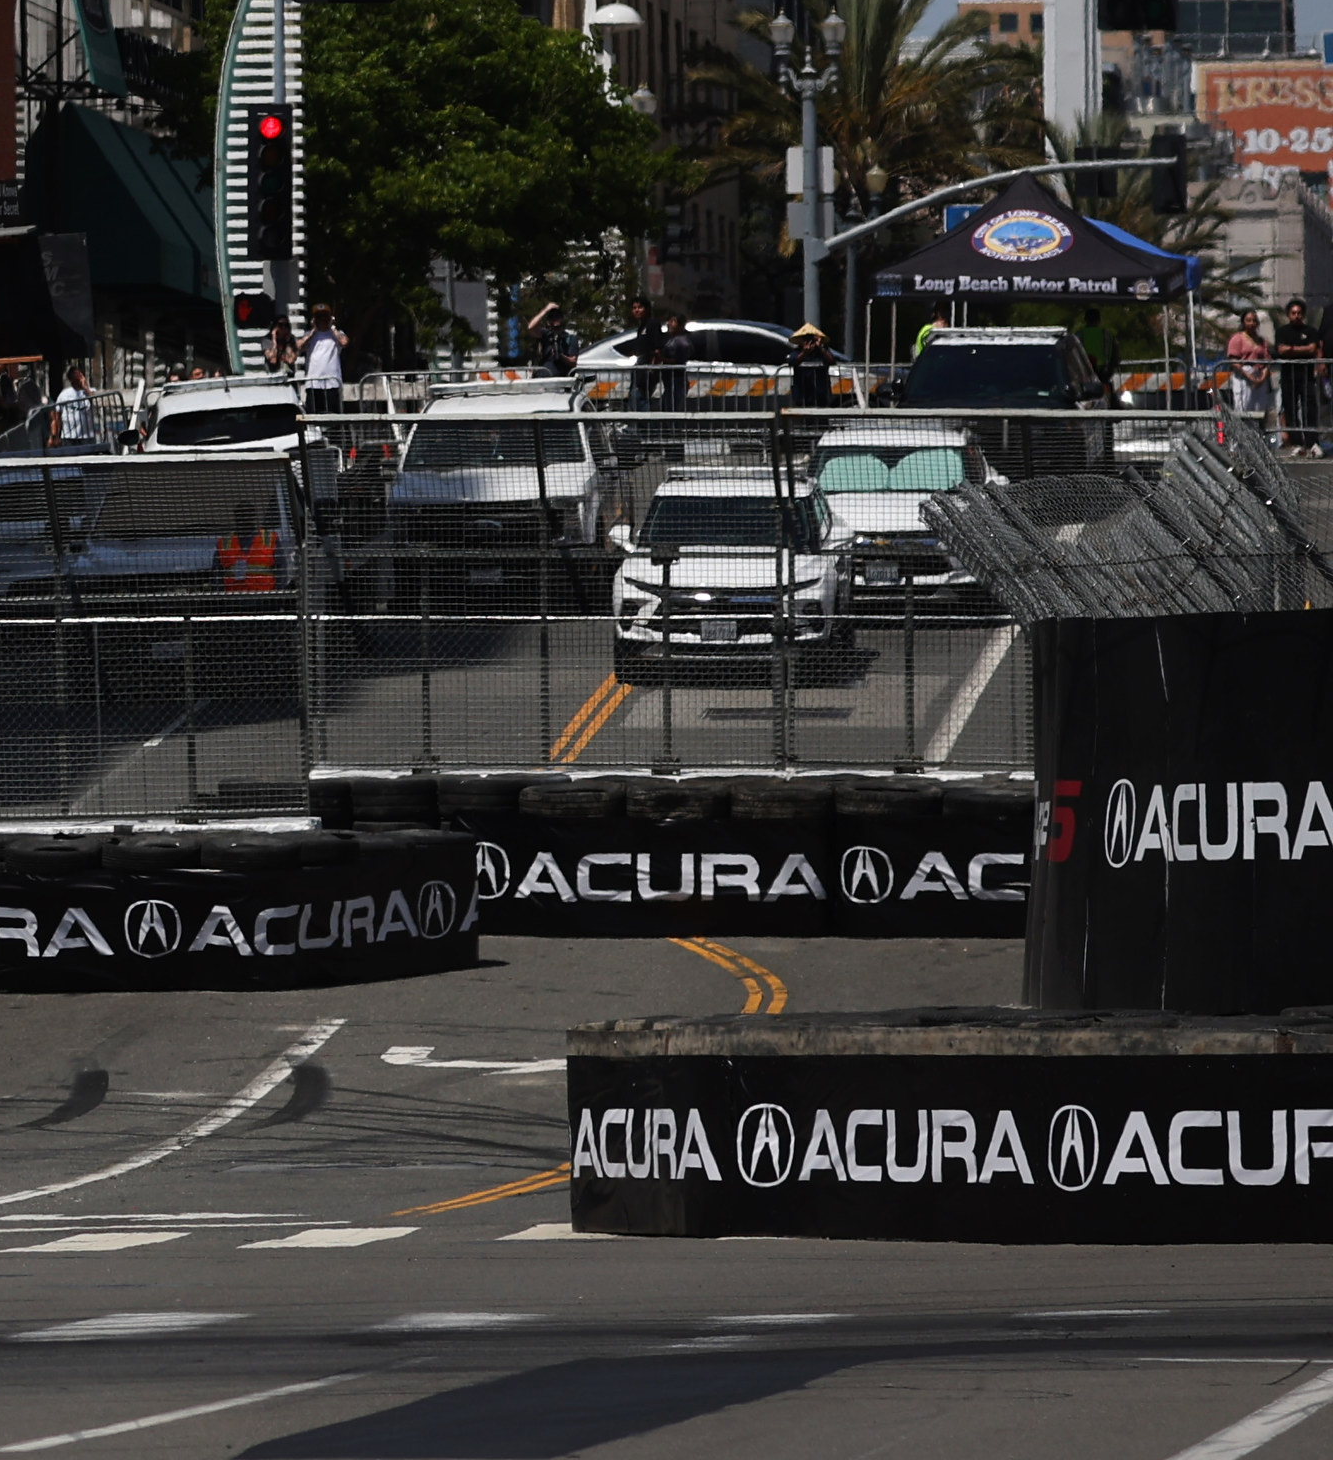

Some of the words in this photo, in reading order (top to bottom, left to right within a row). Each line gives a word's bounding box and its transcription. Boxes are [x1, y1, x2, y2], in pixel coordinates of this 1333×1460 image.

[914, 273, 955, 295] Long
[959, 275, 1008, 291] Beach
[1013, 276, 1065, 293] Motor
[1069, 277, 1118, 293] Patrol
[1133, 780, 1333, 862] ACURA
[514, 850, 827, 903] ACURA
[188, 888, 420, 957] ACURA
[572, 1106, 723, 1182] ACURA
[797, 1109, 1034, 1185] ACURA
[1102, 1109, 1333, 1187] ACUR
